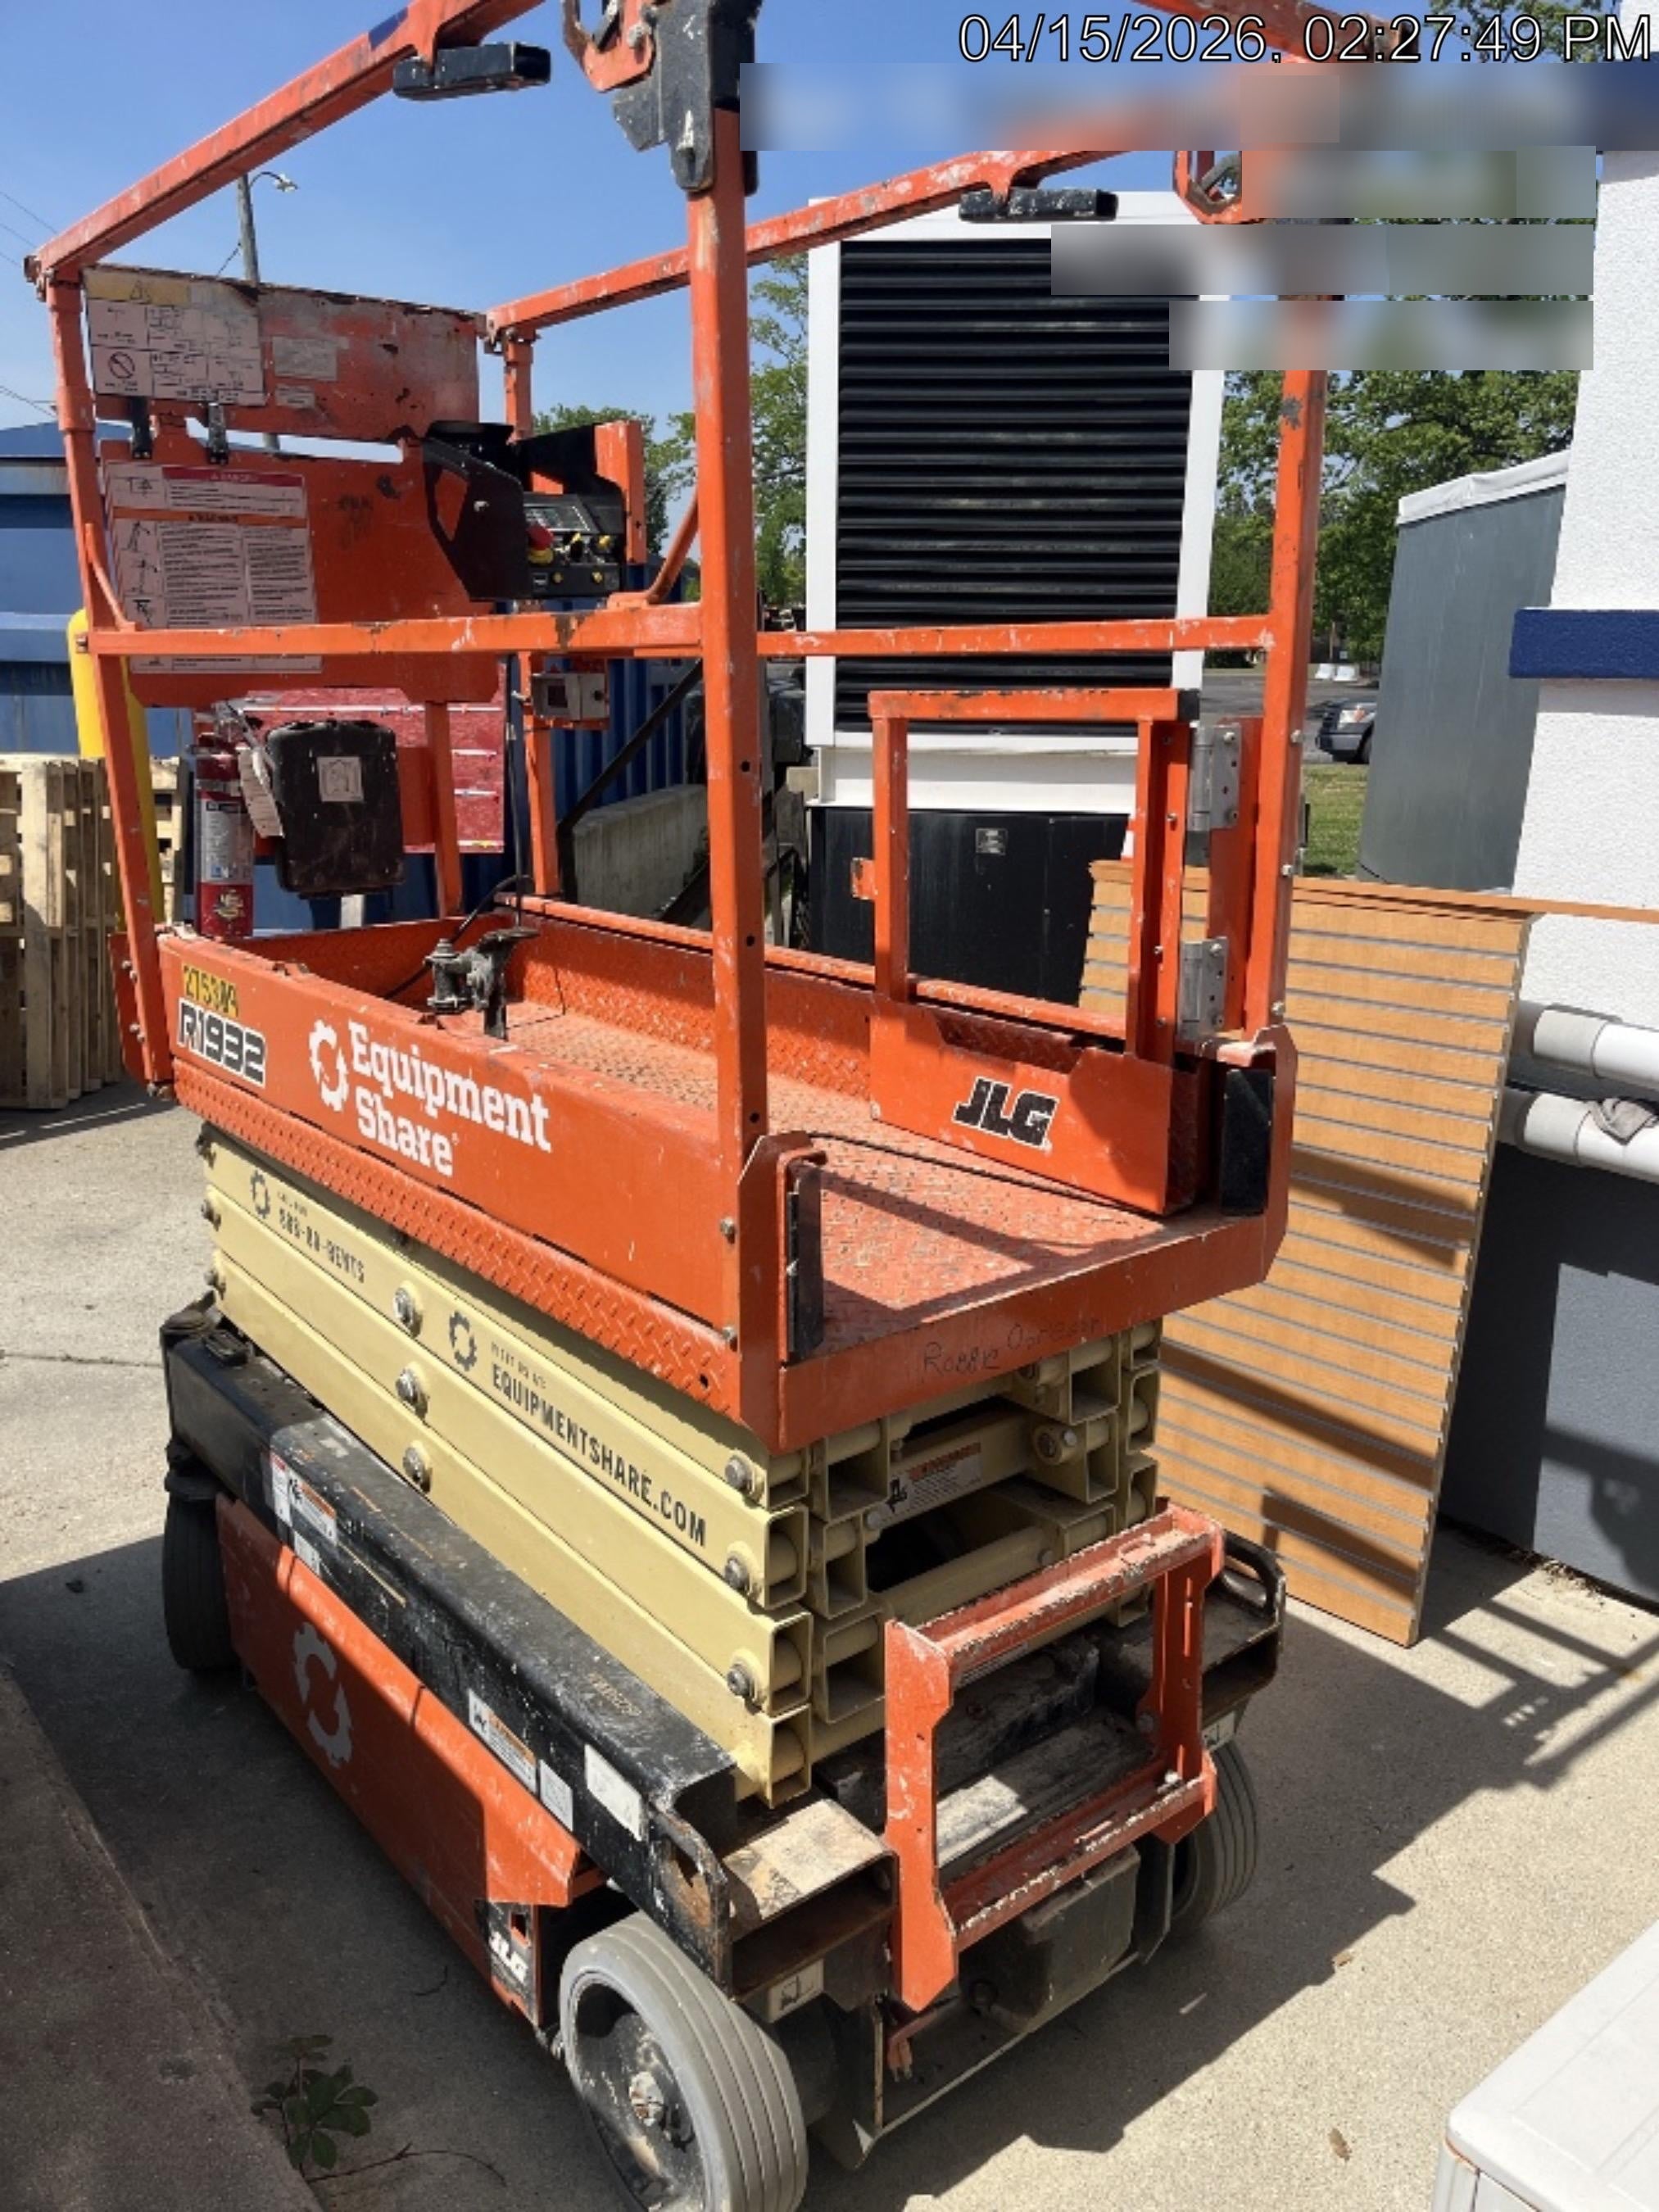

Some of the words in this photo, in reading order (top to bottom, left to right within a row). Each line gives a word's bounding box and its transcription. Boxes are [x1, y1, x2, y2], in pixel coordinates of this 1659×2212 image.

[178, 997, 266, 1089] R1932
[348, 1018, 552, 1154] Equipment
[356, 1086, 453, 1177] Share
[952, 1077, 1059, 1149] JLG
[492, 1362, 707, 1547] EQUIPMENTSHARE.COM
